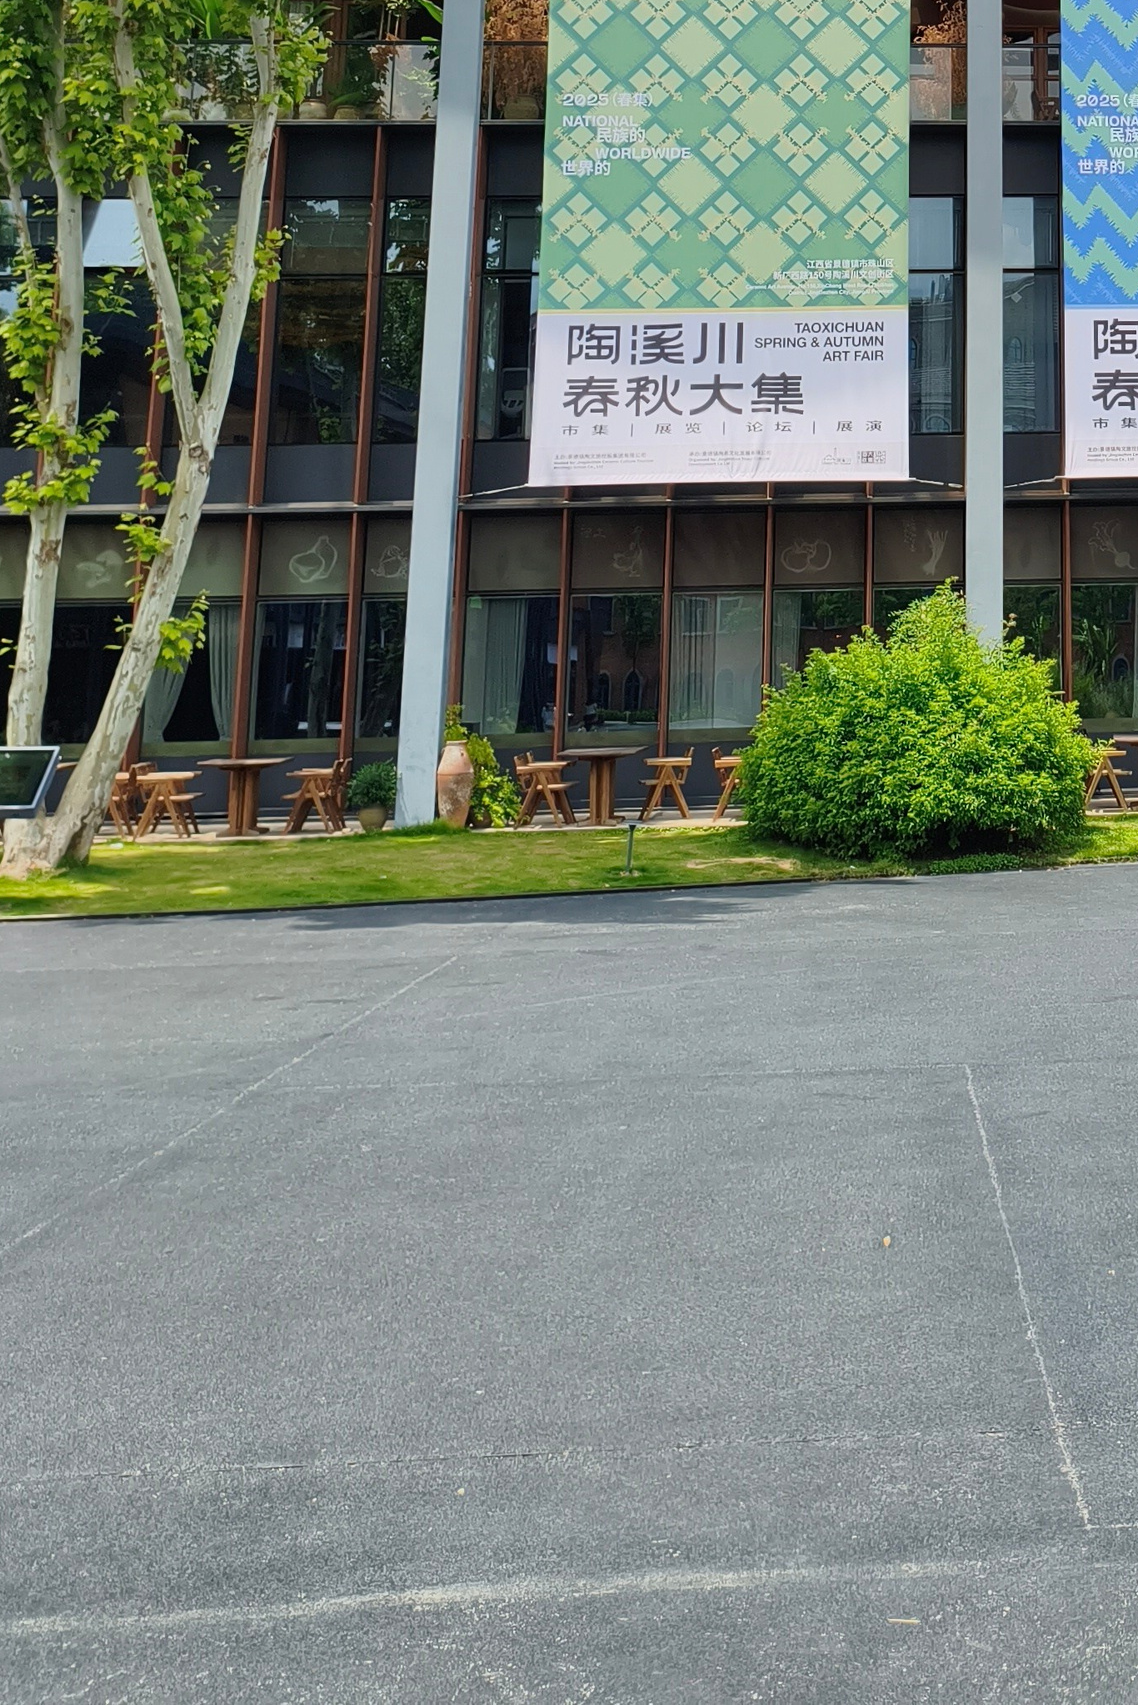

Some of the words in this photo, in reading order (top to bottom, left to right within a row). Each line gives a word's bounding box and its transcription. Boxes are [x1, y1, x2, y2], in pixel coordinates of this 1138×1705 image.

[562, 115, 638, 128] NATIONAL
[596, 126, 646, 143] 民族的
[595, 147, 691, 160] WORLDWIDE
[561, 160, 610, 176] 世界的
[1077, 159, 1125, 174] 世界的
[795, 322, 884, 334] TAOXICHUAN
[567, 322, 744, 365] 陶溪川
[754, 337, 806, 349] SPRING
[811, 337, 820, 348] &
[824, 336, 884, 348] AUTUMN
[822, 351, 850, 362] ART
[854, 350, 884, 362] FAIR
[562, 372, 804, 417] 春秋大集
